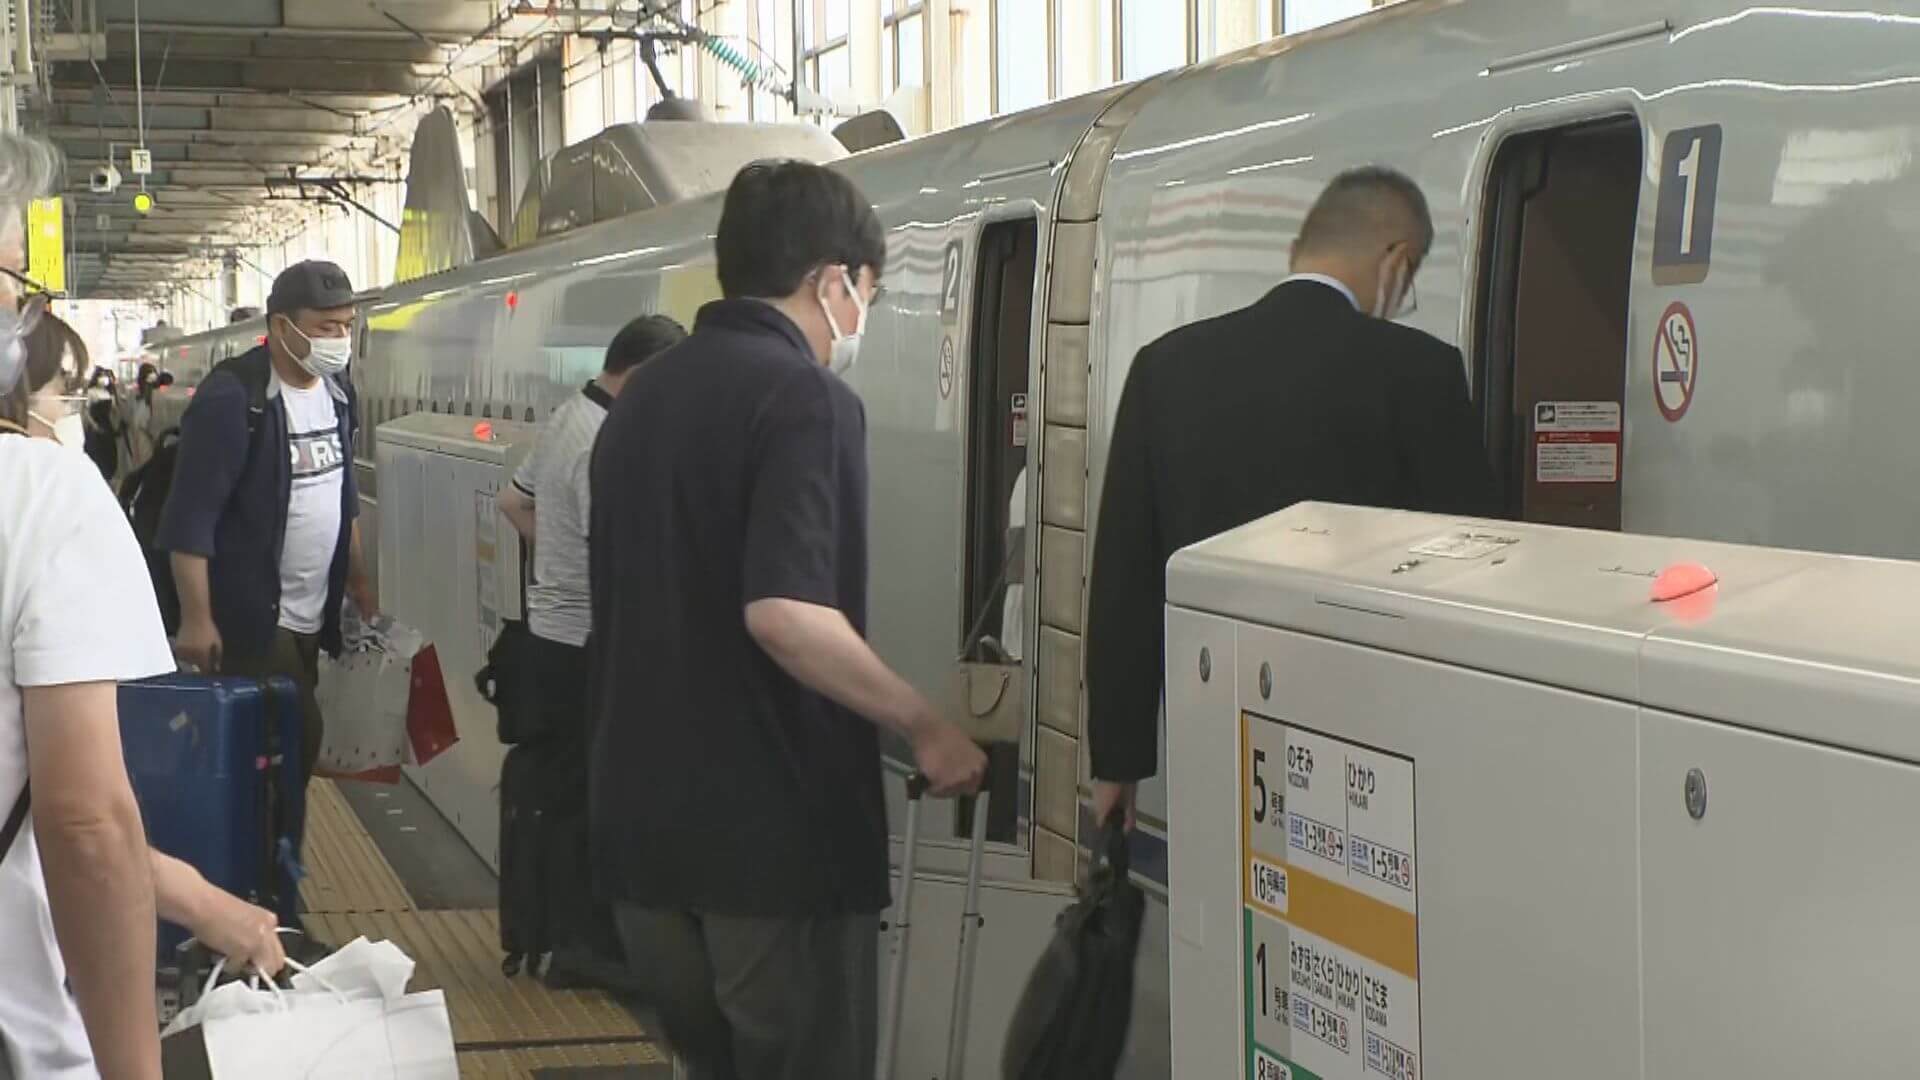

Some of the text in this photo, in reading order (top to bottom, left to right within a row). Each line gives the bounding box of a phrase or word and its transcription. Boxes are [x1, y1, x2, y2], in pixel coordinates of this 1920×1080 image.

[1678, 138, 1701, 254] 1
[944, 247, 959, 310] 2
[1253, 748, 1267, 823] 5
[1287, 745, 1314, 774] のぞみ
[1348, 762, 1376, 794] ひかり
[1256, 943, 1267, 1016] 1
[1291, 941, 1388, 1009] みずほ さくら ひかり こだま
